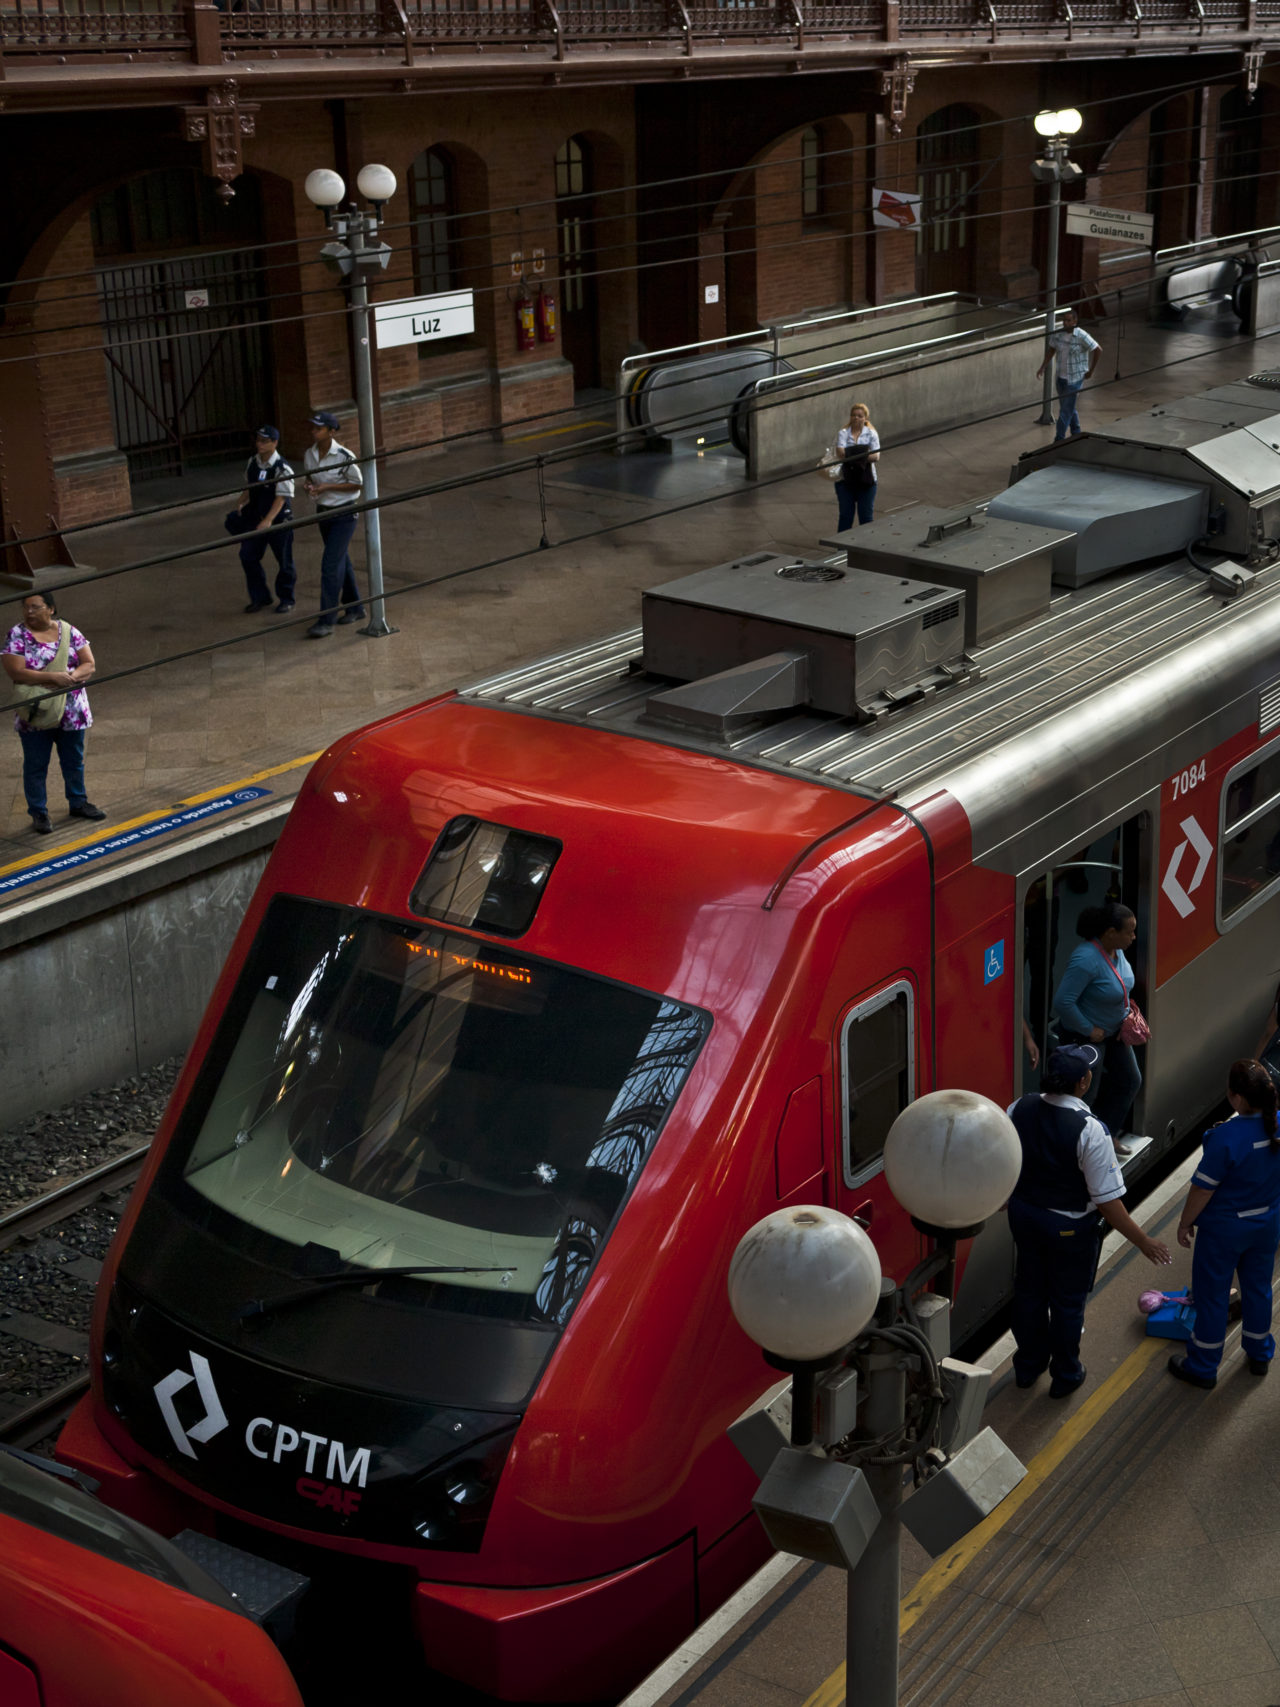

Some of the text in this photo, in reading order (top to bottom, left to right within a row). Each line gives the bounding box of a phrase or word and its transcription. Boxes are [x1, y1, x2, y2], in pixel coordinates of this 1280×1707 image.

[1089, 208, 1125, 220] Plataforma
[1090, 223, 1145, 240] Guaianazes
[412, 317, 441, 336] Luz
[1172, 758, 1206, 801] 7084
[181, 799, 233, 819] Aguarde
[140, 822, 173, 836] trem
[105, 833, 141, 848] antes
[86, 846, 105, 855] da
[51, 853, 89, 868] faixa
[245, 1416, 371, 1489] CPTM
[296, 1477, 362, 1517] CAF
